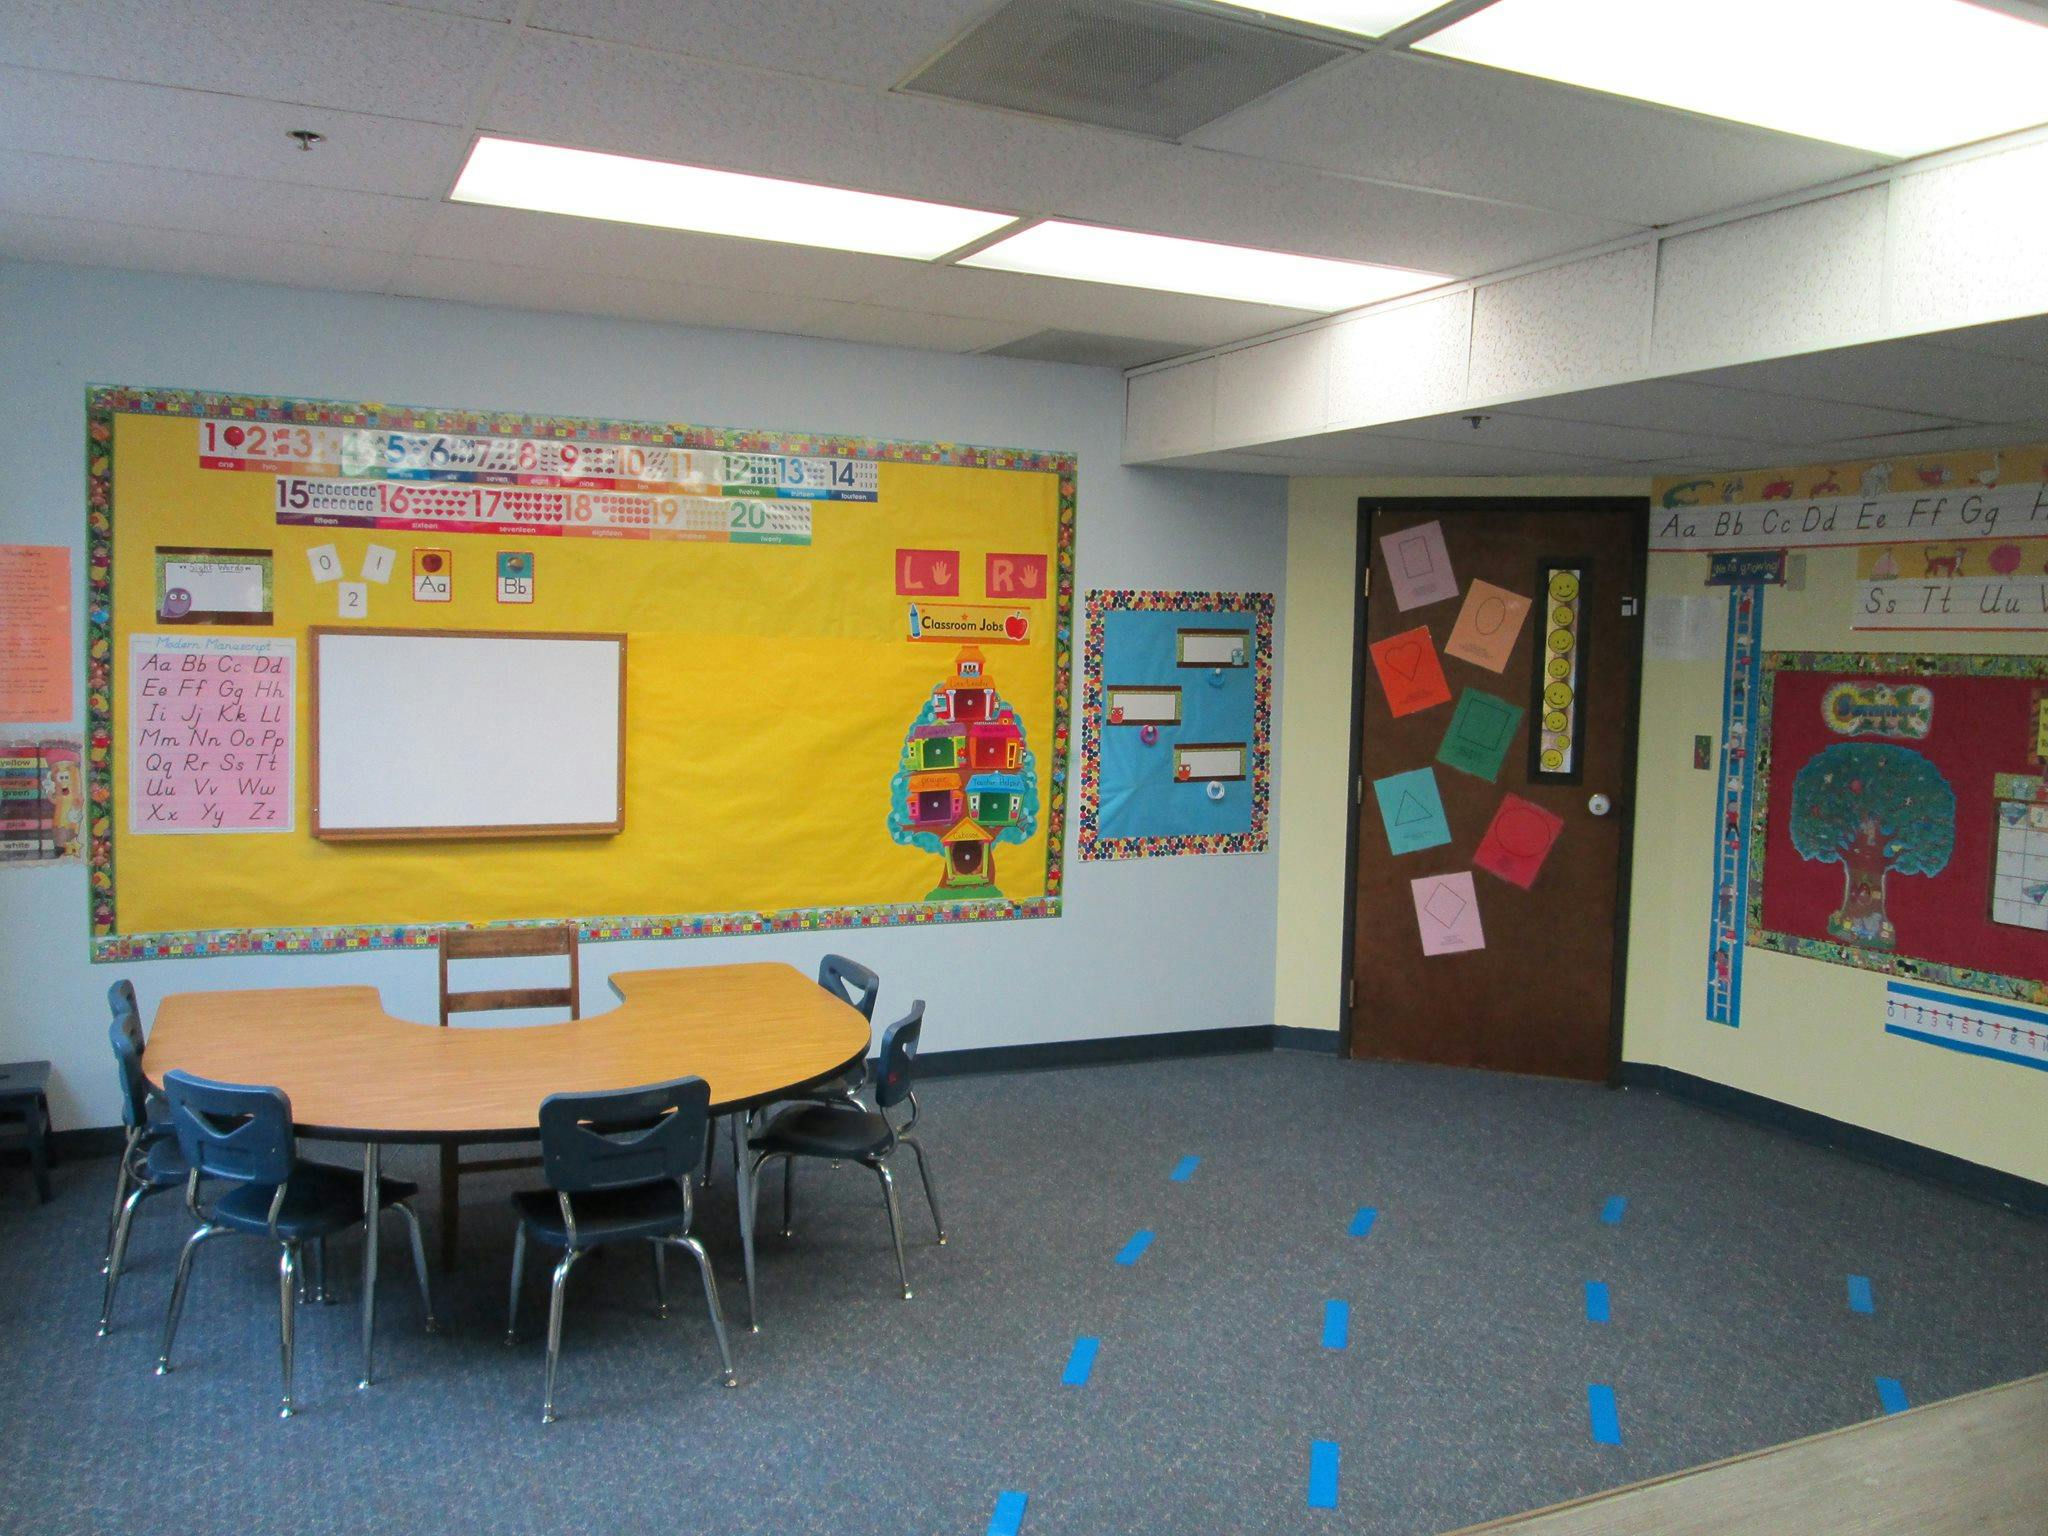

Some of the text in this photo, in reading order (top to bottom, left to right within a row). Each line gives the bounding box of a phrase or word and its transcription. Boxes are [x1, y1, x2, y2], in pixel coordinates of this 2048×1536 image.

[205, 422, 215, 451] 1
[246, 425, 267, 455] 2
[293, 428, 313, 458] 3
[384, 435, 406, 463] 5
[430, 438, 450, 465] 6
[475, 440, 492, 467] 7
[519, 442, 537, 470] 8
[560, 444, 579, 471] 9
[617, 447, 645, 475] 10
[671, 452, 692, 478] 11
[722, 455, 750, 481] 12
[778, 457, 804, 484] 13
[830, 460, 855, 487] 14
[218, 461, 234, 469] one
[486, 475, 508, 483] seven
[739, 488, 760, 496] twelve
[841, 492, 867, 501] fourteen
[277, 479, 765, 529] 15 16 17 18 19 20
[1660, 513, 1696, 538] Aa
[1714, 511, 1743, 536] Bb
[1762, 509, 1791, 534] Cc
[1802, 505, 1838, 533] Dd
[1856, 502, 1886, 530] Ee
[1908, 498, 1948, 528] Ff
[1961, 495, 1999, 536] Gg
[314, 516, 338, 525] fifteen
[412, 521, 438, 530] sixteen
[499, 526, 536, 534] seventeen
[592, 529, 623, 538] eighteen
[760, 535, 782, 544] twenty
[319, 555, 331, 570] 0
[904, 556, 925, 589] L
[993, 559, 1015, 591] R
[419, 575, 446, 592] Aa
[505, 577, 527, 594] Bb
[348, 591, 358, 607] 2
[1865, 587, 1896, 614] Ss
[1922, 586, 1952, 614] Tt
[1979, 585, 2020, 614] Uu
[922, 616, 1004, 632] Classroom Jobs
[155, 637, 271, 654] Modern Manuscript
[141, 653, 283, 674] Aa Bb Cc Dd
[142, 678, 284, 705] Ee Ff Gg Hh
[147, 703, 281, 730] Ii Jj Kk Ll
[139, 729, 284, 754] Mm Nn Oo Pp
[146, 753, 278, 779] Qq Rr Ss Tt
[2, 790, 30, 799] green
[146, 778, 276, 796] Uu Vv Ww
[147, 802, 276, 828] Xx Yy Zz
[4, 840, 30, 849] white
[1887, 1006, 1895, 1017] 0
[1903, 1008, 1907, 1019] 1
[1916, 1013, 1923, 1024] 2
[1931, 1017, 1938, 1028] 3
[1946, 1019, 1953, 1030] 4
[1962, 1022, 1969, 1034] 5
[1976, 1026, 1983, 1037] 6
[1993, 1029, 2000, 1041] 7
[2010, 1033, 2018, 1045] 8
[2028, 1037, 2036, 1049] 9
